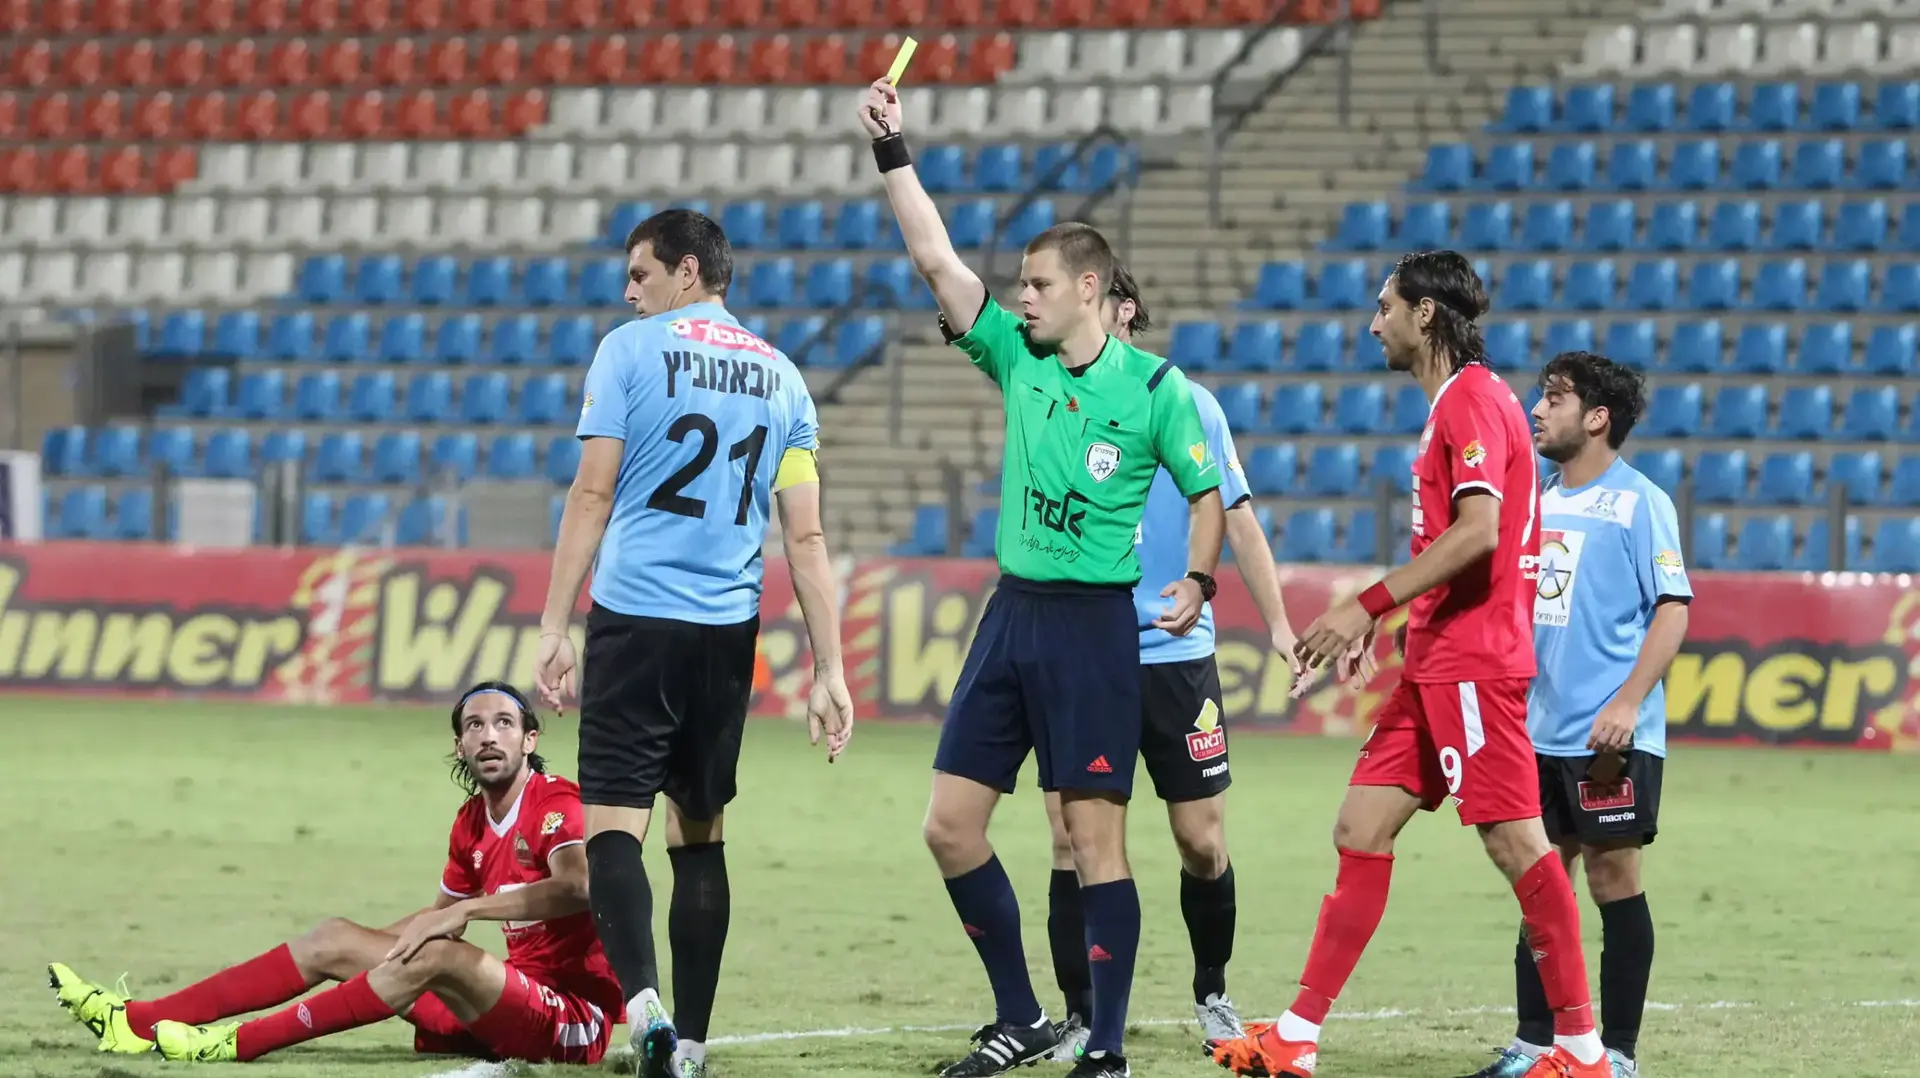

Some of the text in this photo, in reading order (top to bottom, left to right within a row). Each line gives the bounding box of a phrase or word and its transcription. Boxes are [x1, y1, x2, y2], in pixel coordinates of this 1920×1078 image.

[646, 413, 769, 526] 21
[1439, 746, 1462, 794] 9
[1599, 812, 1636, 823] macron
